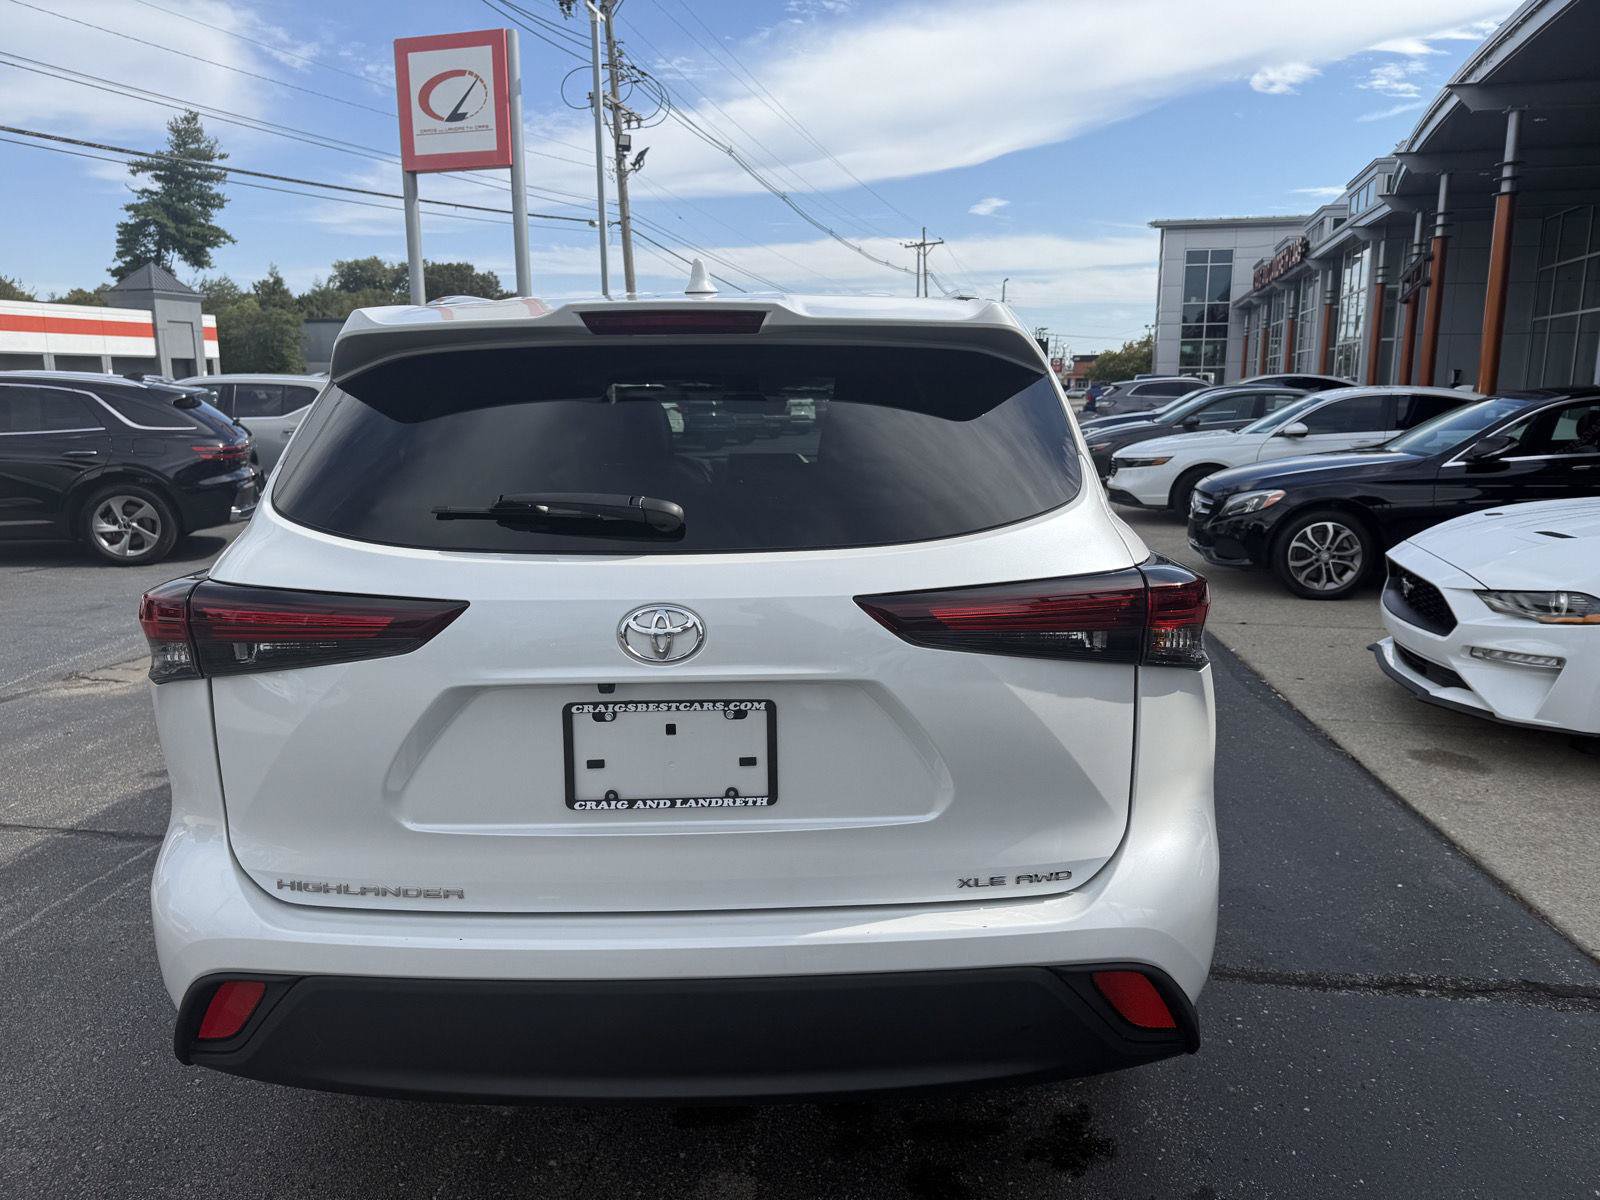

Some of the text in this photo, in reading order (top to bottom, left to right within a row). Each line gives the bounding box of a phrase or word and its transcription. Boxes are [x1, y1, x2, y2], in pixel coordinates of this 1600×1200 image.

[572, 702, 766, 713] CRAIGSBESTCARS.COM
[573, 797, 768, 810] CRAIG AND LANDRETH
[958, 871, 1072, 889] XLE AWD
[276, 878, 465, 899] HIGHLANDER
